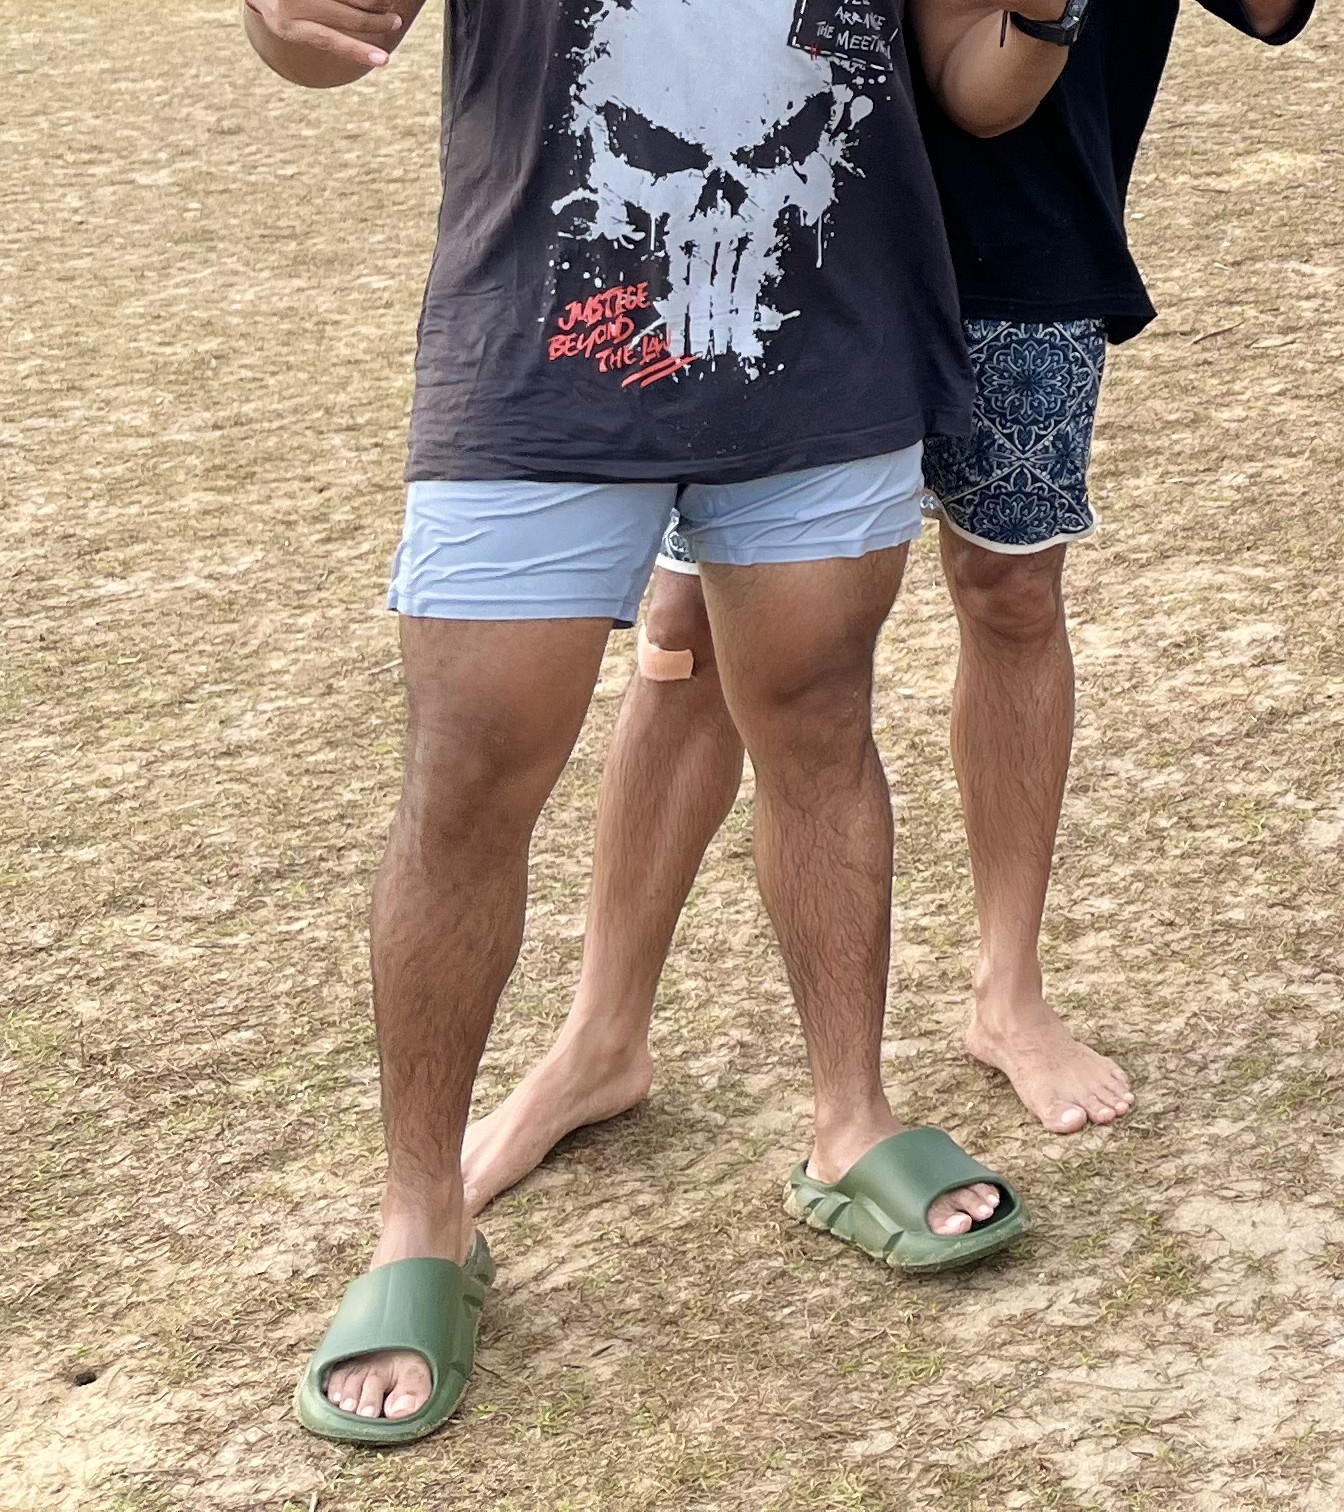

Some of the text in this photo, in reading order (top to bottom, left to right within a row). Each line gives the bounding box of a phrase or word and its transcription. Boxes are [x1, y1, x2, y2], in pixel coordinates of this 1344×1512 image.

[816, 21, 835, 38] THE
[548, 313, 636, 361] BEYOND
[595, 344, 638, 372] THE
